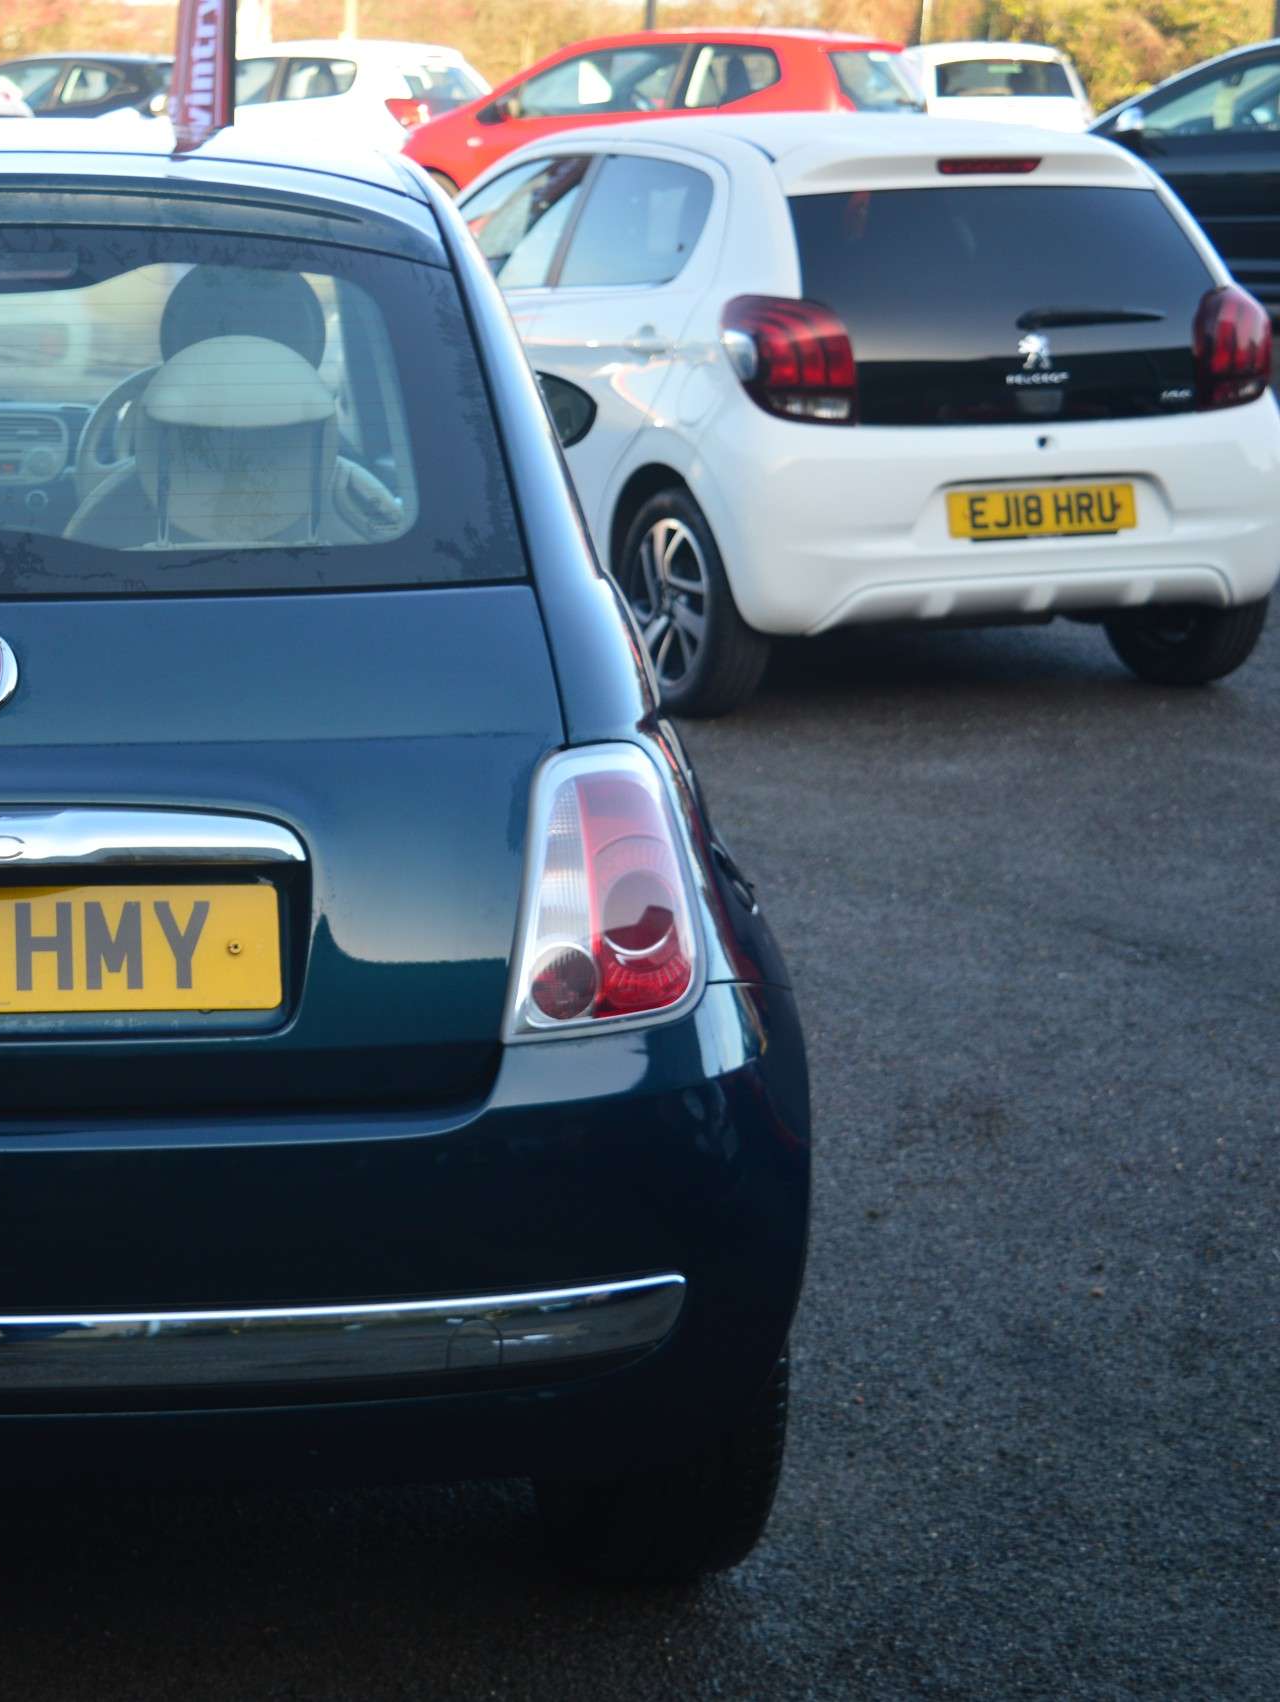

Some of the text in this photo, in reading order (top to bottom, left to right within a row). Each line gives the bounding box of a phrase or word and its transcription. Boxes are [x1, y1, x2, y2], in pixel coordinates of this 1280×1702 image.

[969, 491, 1118, 529] EJ18 HRU
[14, 901, 210, 991] HMY
